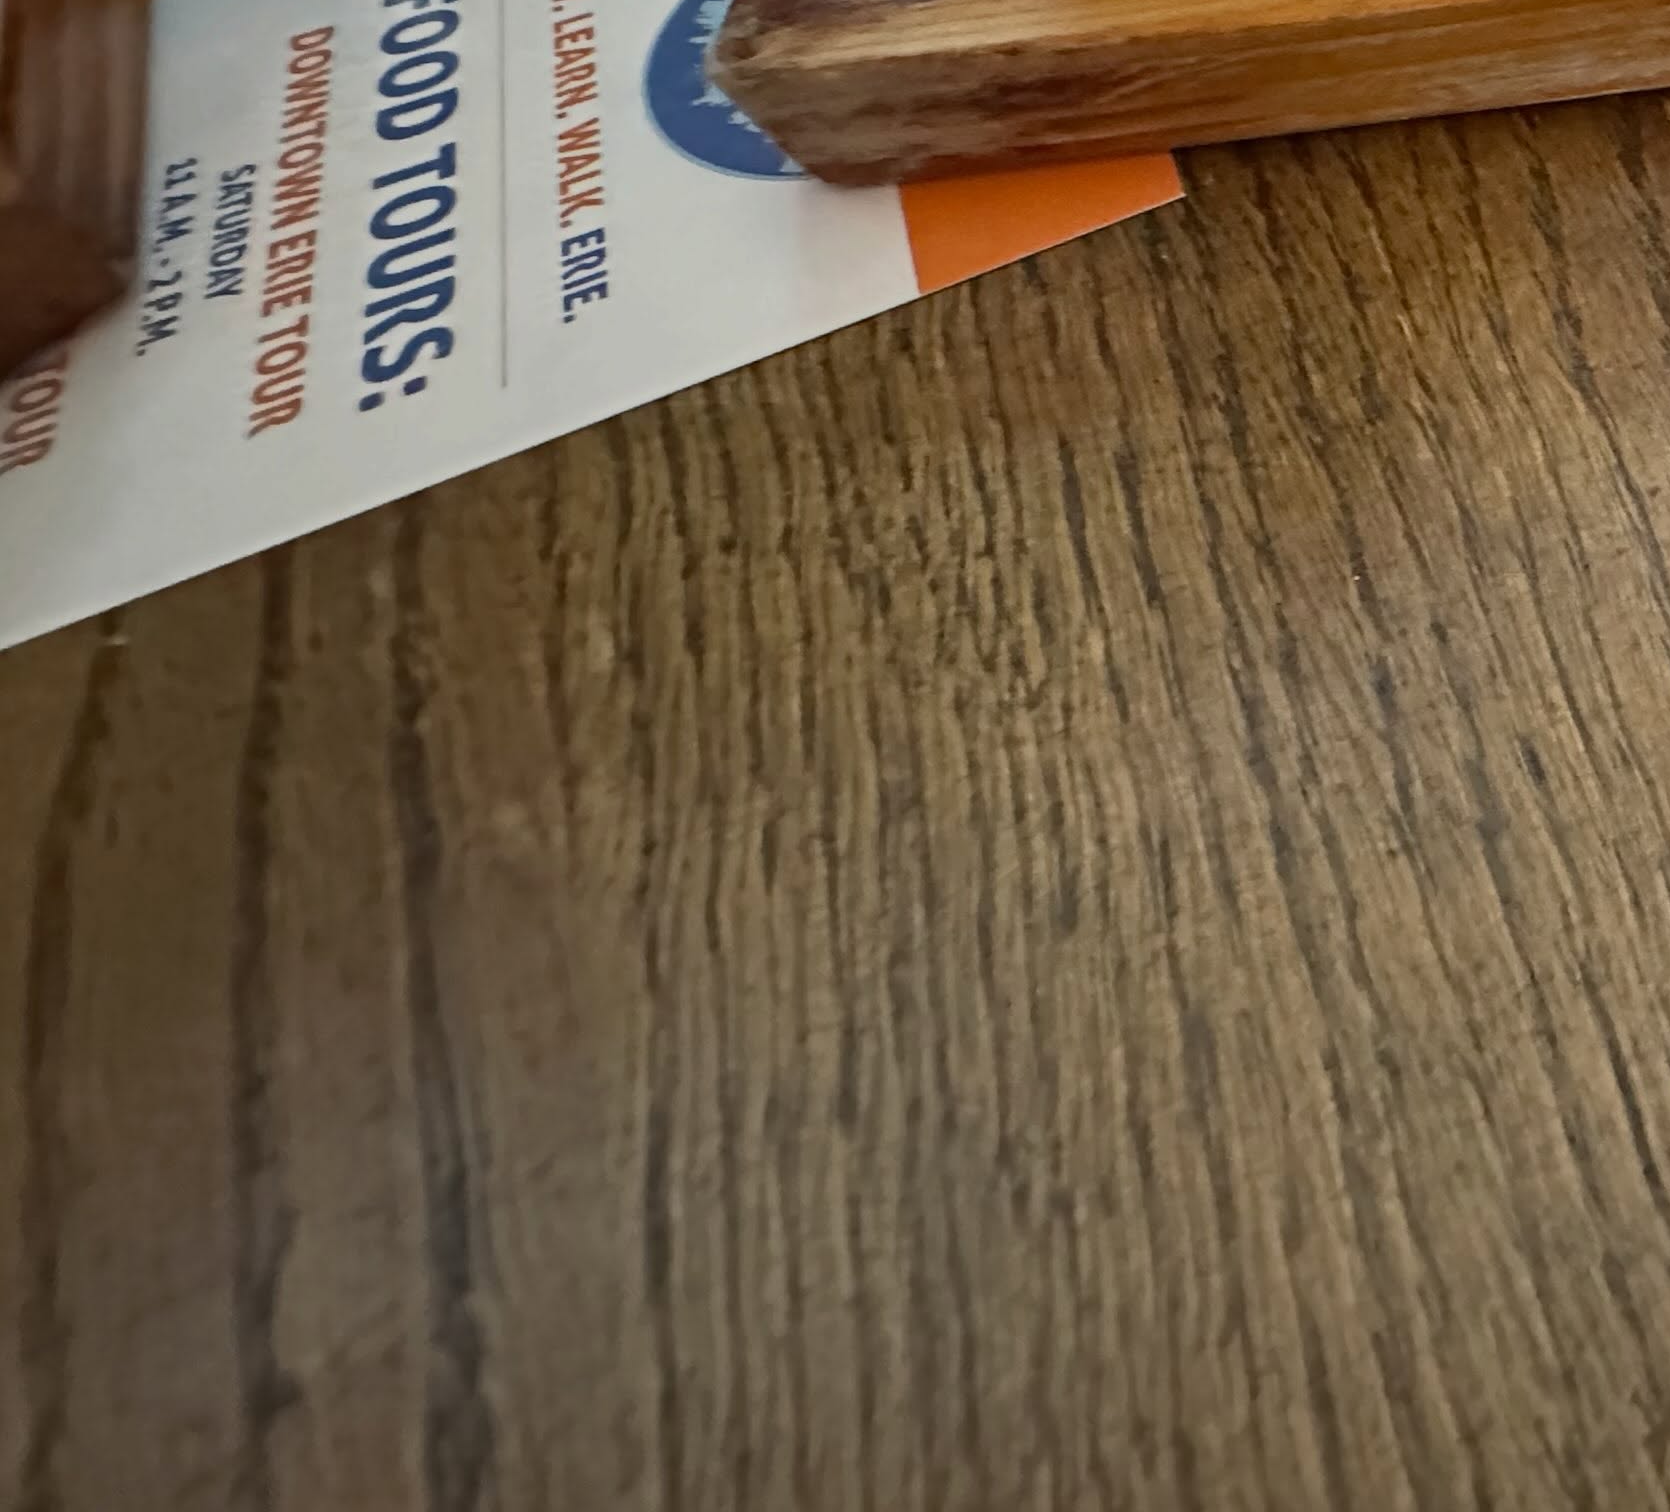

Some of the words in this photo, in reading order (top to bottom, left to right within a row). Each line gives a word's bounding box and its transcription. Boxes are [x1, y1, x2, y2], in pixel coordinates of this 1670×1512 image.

[553, 12, 599, 120] LEARN.
[164, 157, 198, 191] 11
[270, 25, 335, 231] DOWNTOWN
[557, 117, 605, 228] WALK.
[153, 192, 198, 254] A.M.
[204, 164, 257, 300] SATURDAY
[259, 229, 317, 318] ERIE
[136, 292, 184, 357] P.M.
[148, 270, 183, 293] 2
[358, 141, 460, 413] TOURS:
[560, 226, 608, 323] ERIE.
[245, 314, 309, 439] TOUR
